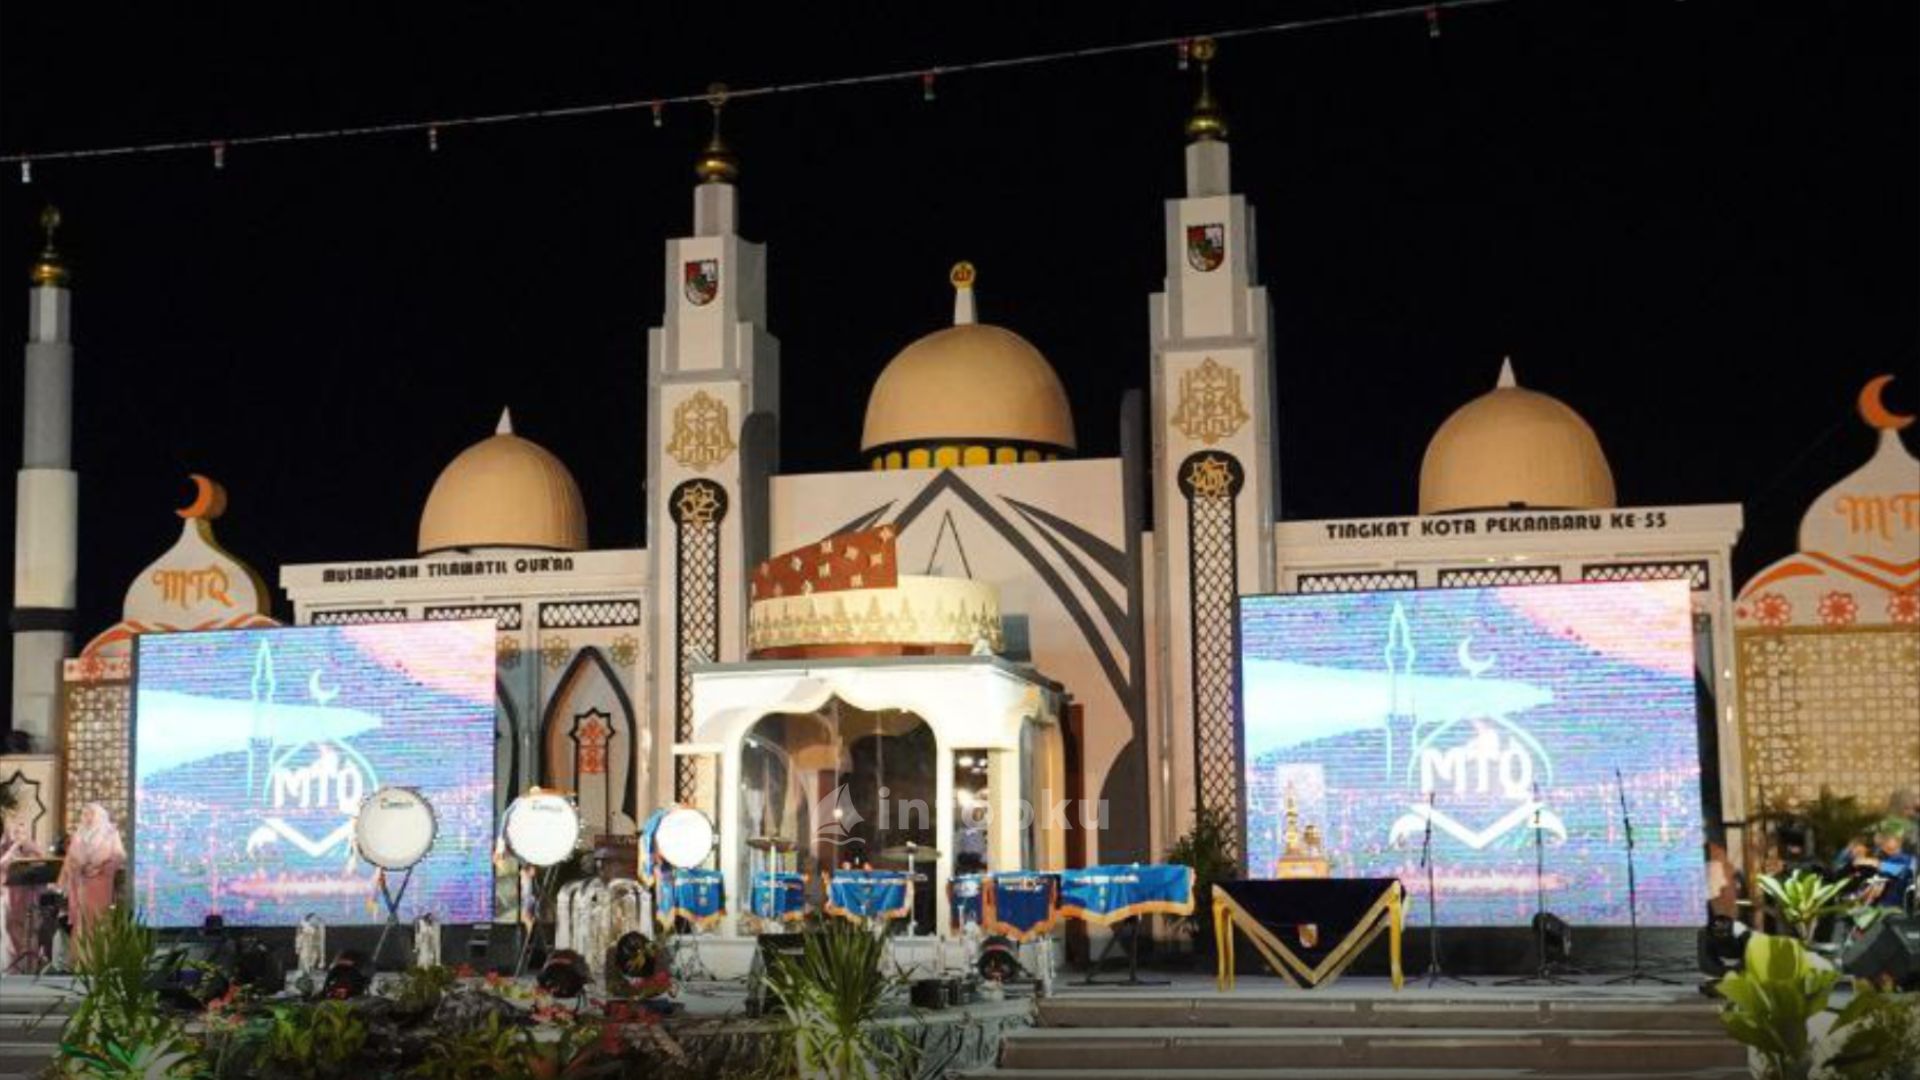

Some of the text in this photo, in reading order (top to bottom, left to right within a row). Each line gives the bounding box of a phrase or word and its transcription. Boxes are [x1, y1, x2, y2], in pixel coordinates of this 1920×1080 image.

[1326, 512, 1666, 539] TINGKAT KOTA PEKANBARU KE-55
[1834, 493, 1920, 541] MT
[515, 557, 573, 573] QUR'AN
